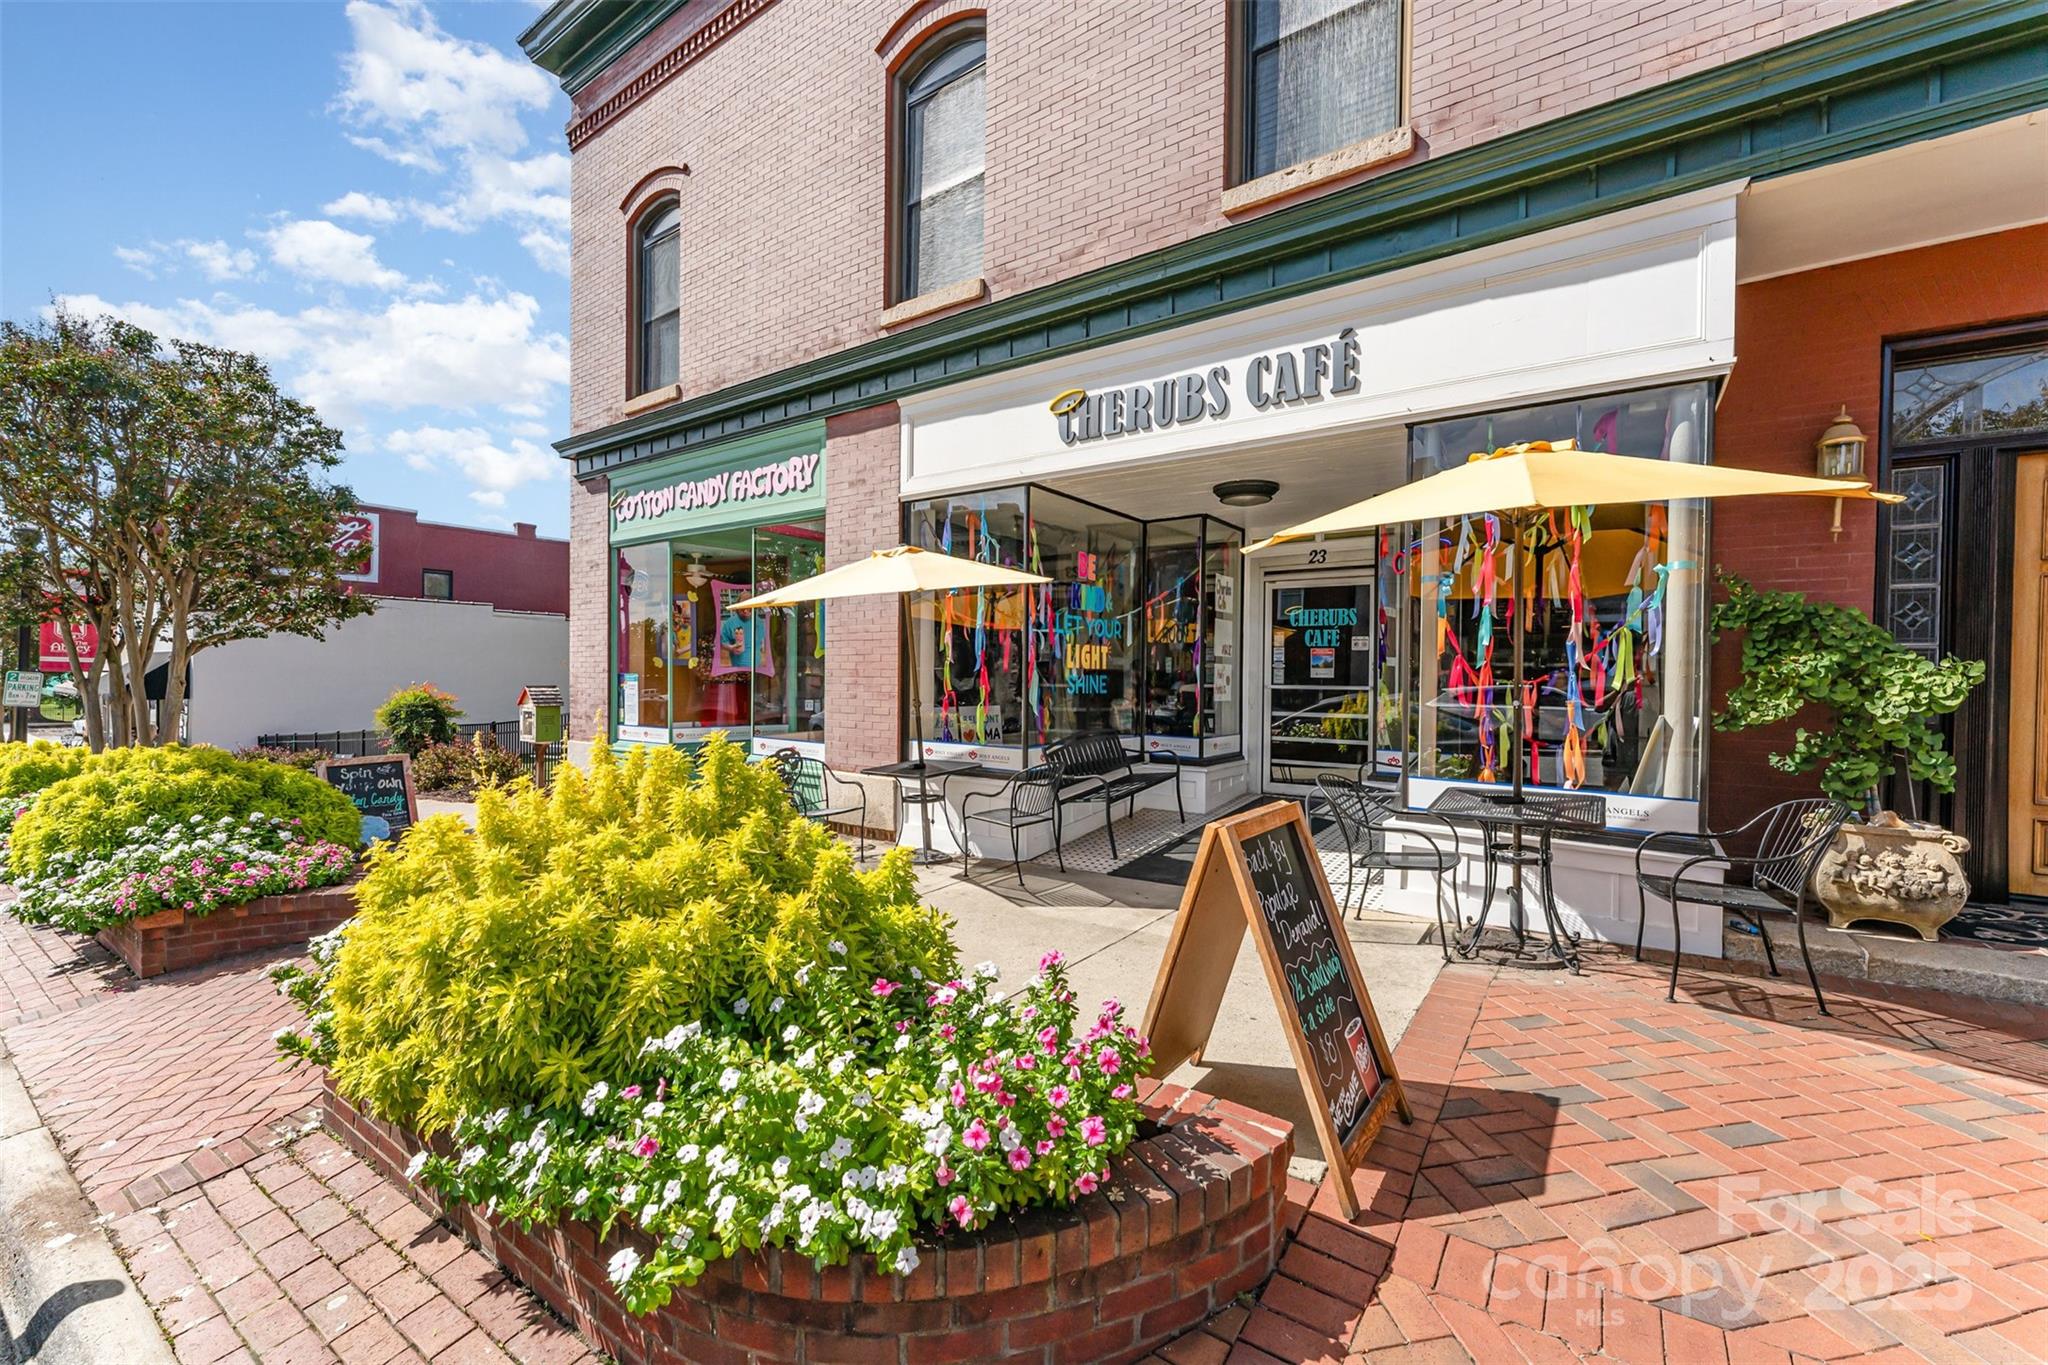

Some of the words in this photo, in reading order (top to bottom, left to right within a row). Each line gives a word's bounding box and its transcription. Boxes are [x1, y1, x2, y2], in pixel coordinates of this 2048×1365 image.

[1057, 366, 1230, 444] CHERUBS
[1246, 328, 1358, 408] CAFÉ
[615, 485, 675, 522] COTTON
[674, 472, 730, 510] CANDY
[731, 454, 819, 500] FACTORY
[1077, 551, 1096, 581] BE
[1308, 549, 1327, 564] 23
[1072, 582, 1105, 613] KIND
[1055, 609, 1082, 635] LET
[1086, 616, 1122, 639] YOUR
[1290, 607, 1358, 627] CHERUBS
[1304, 626, 1340, 647] CAFÉ
[1066, 643, 1109, 670] LIGHT
[8, 672, 17, 681] 2
[1067, 674, 1107, 694] SHINE
[8, 683, 39, 692] PARKING
[341, 767, 374, 788] Spin
[377, 777, 404, 790] own
[371, 791, 405, 811] Candy
[1606, 807, 1650, 817] ANGELS
